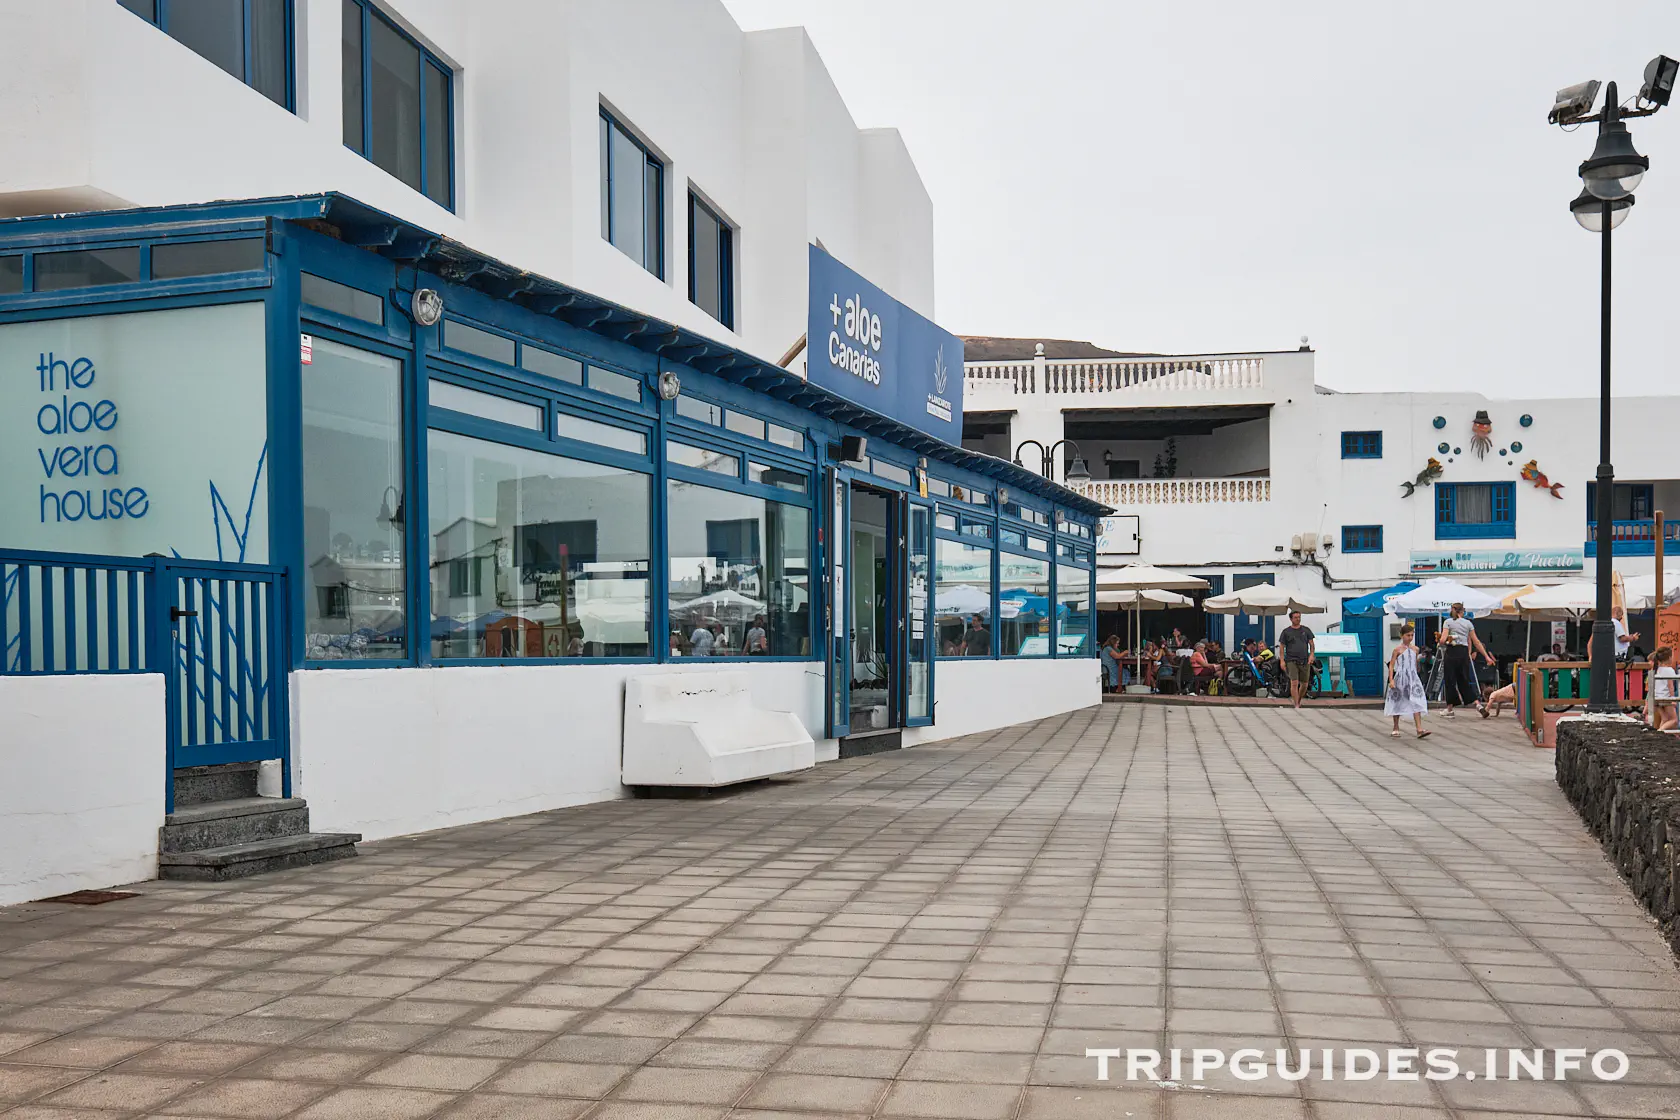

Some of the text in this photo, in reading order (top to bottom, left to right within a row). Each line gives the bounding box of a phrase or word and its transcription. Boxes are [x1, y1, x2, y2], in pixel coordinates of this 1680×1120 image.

[844, 292, 882, 352] aloe
[36, 352, 96, 392] the
[828, 330, 880, 385] Canarias
[37, 394, 119, 435] aloe
[37, 443, 119, 479] vera
[39, 483, 150, 523] house
[1455, 552, 1472, 561] Bar
[1503, 552, 1574, 569] El Puerto
